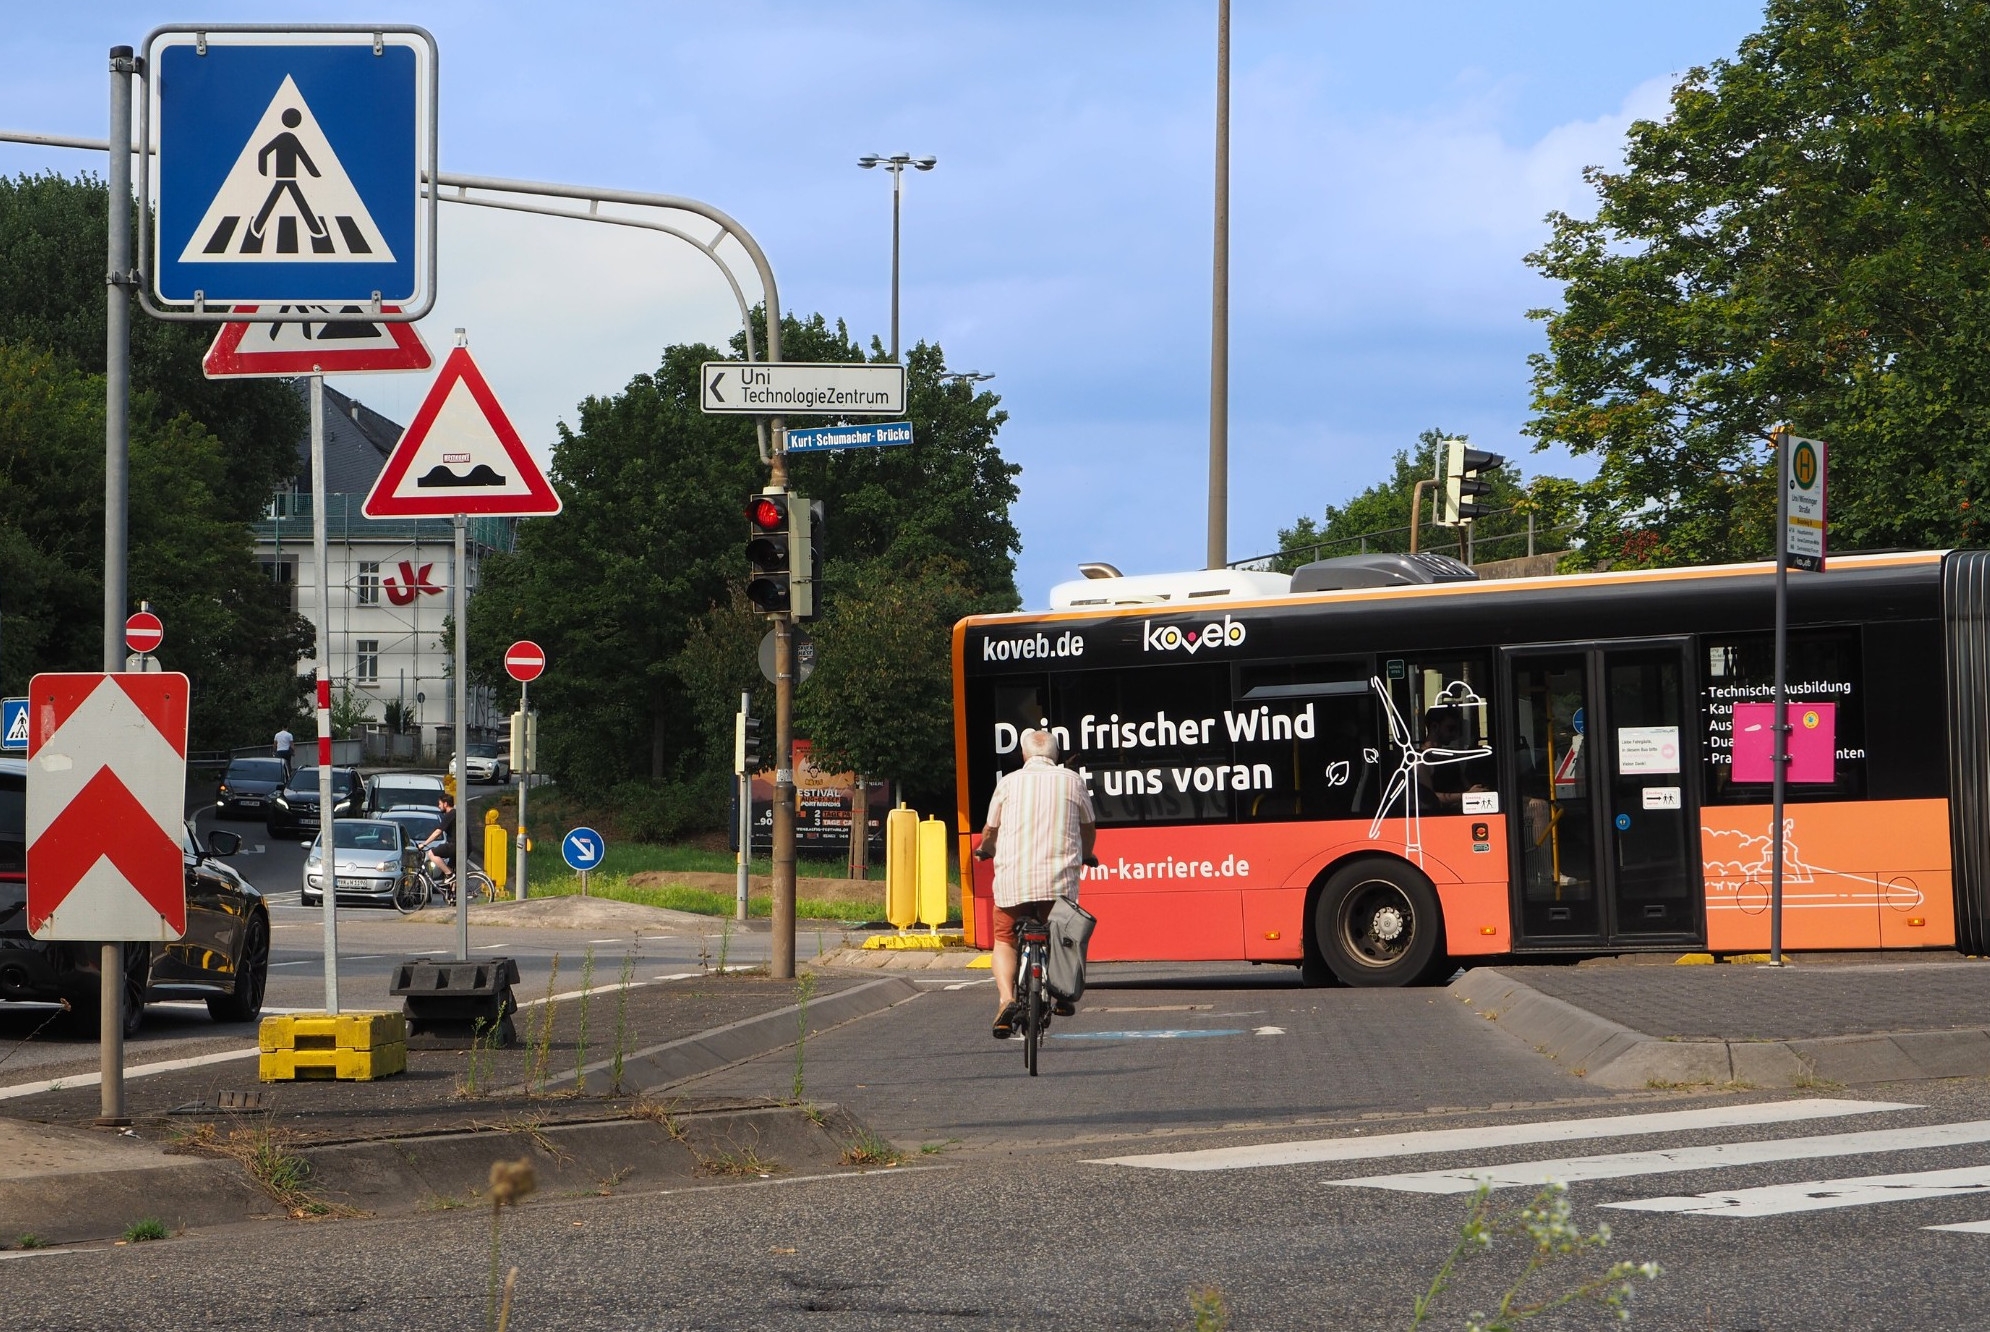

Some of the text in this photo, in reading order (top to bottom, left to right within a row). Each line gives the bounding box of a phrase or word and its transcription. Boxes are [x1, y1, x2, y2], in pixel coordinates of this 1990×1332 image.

[741, 368, 771, 385] Uni
[741, 387, 889, 407] TechnologieZentrum
[791, 428, 910, 448] Kurt-Schumacher-Brücke
[983, 631, 1084, 661] koveb.de
[1144, 615, 1246, 655] koveb
[1708, 681, 1851, 698] Technische Ausbildung
[1081, 710, 1216, 750] frischer
[1224, 703, 1316, 743] Wind
[1104, 768, 1163, 796] uns
[1171, 763, 1273, 793] voran
[796, 788, 841, 798] ESTIVAL
[1080, 853, 1250, 881] vm-karriere.de
